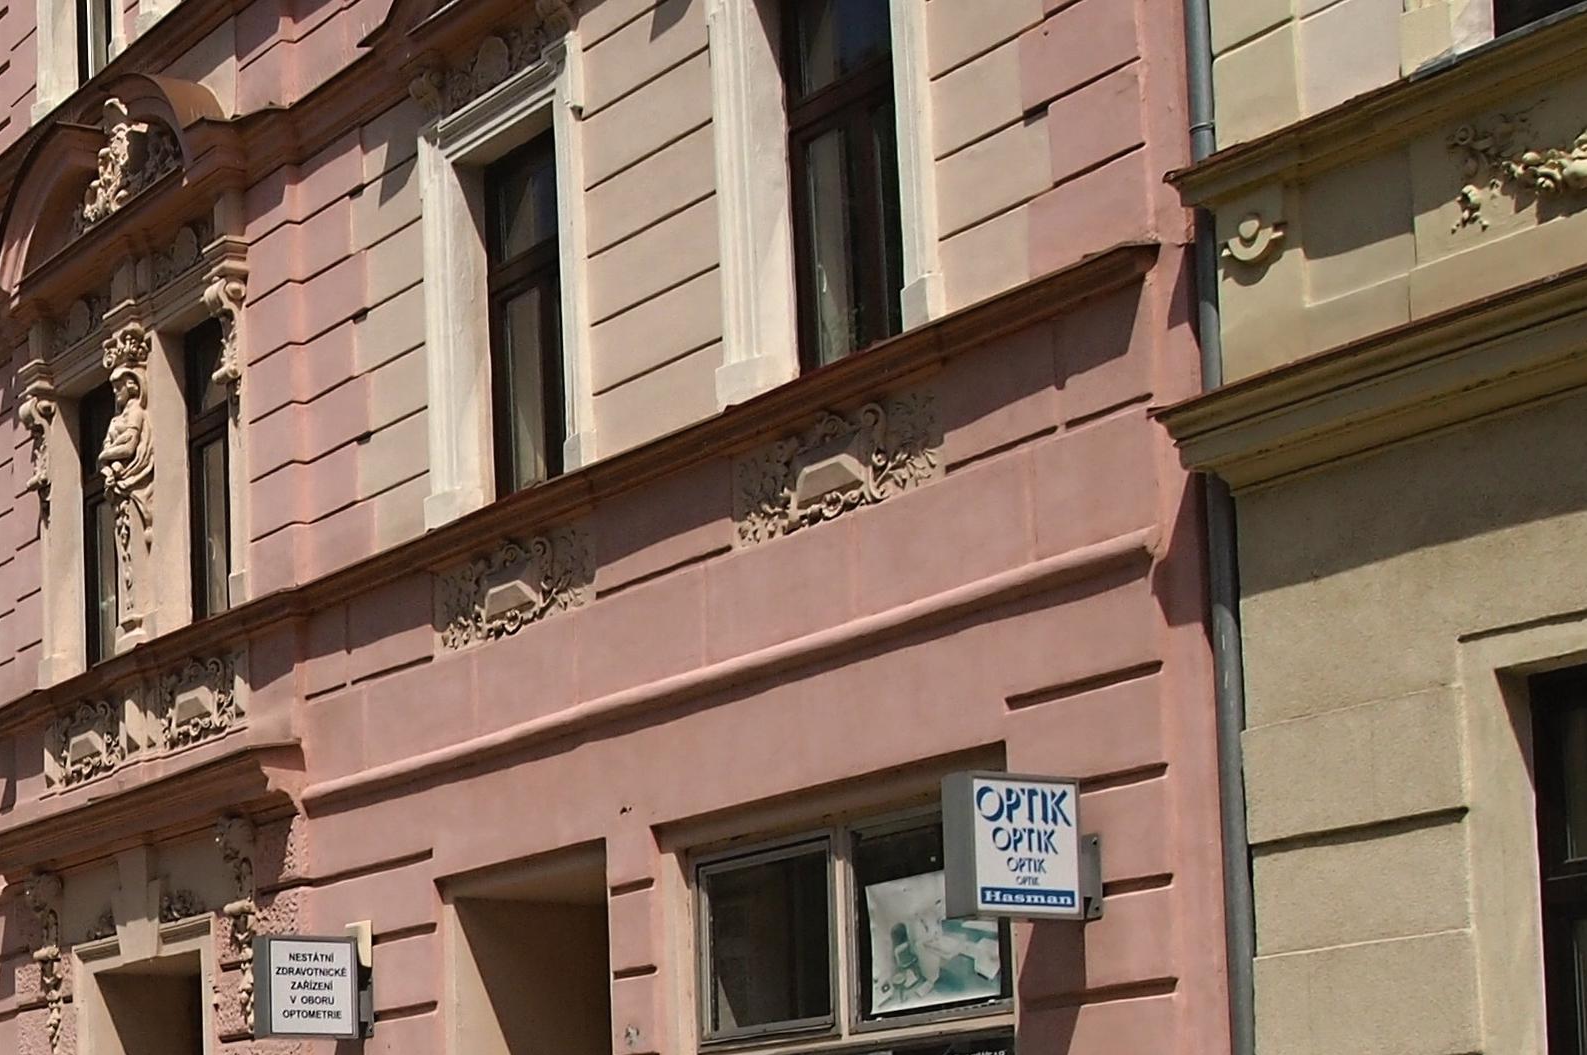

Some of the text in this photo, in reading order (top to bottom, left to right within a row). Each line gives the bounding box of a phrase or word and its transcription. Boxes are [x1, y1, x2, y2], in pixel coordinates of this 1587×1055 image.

[976, 786, 1072, 827] OPTIK
[992, 827, 1059, 854] OPTIK
[1007, 857, 1047, 873] OPTIK
[1015, 876, 1041, 886] OPTIK
[984, 890, 1072, 905] Hasman
[289, 952, 334, 963] NESTÁTNÍ
[275, 966, 347, 977] ZDRAVOTNICKÉ
[290, 980, 333, 990] ZAŘÍZENÍ
[290, 996, 335, 1005] V OBORU
[282, 1010, 342, 1019] OPTOMETRIE
